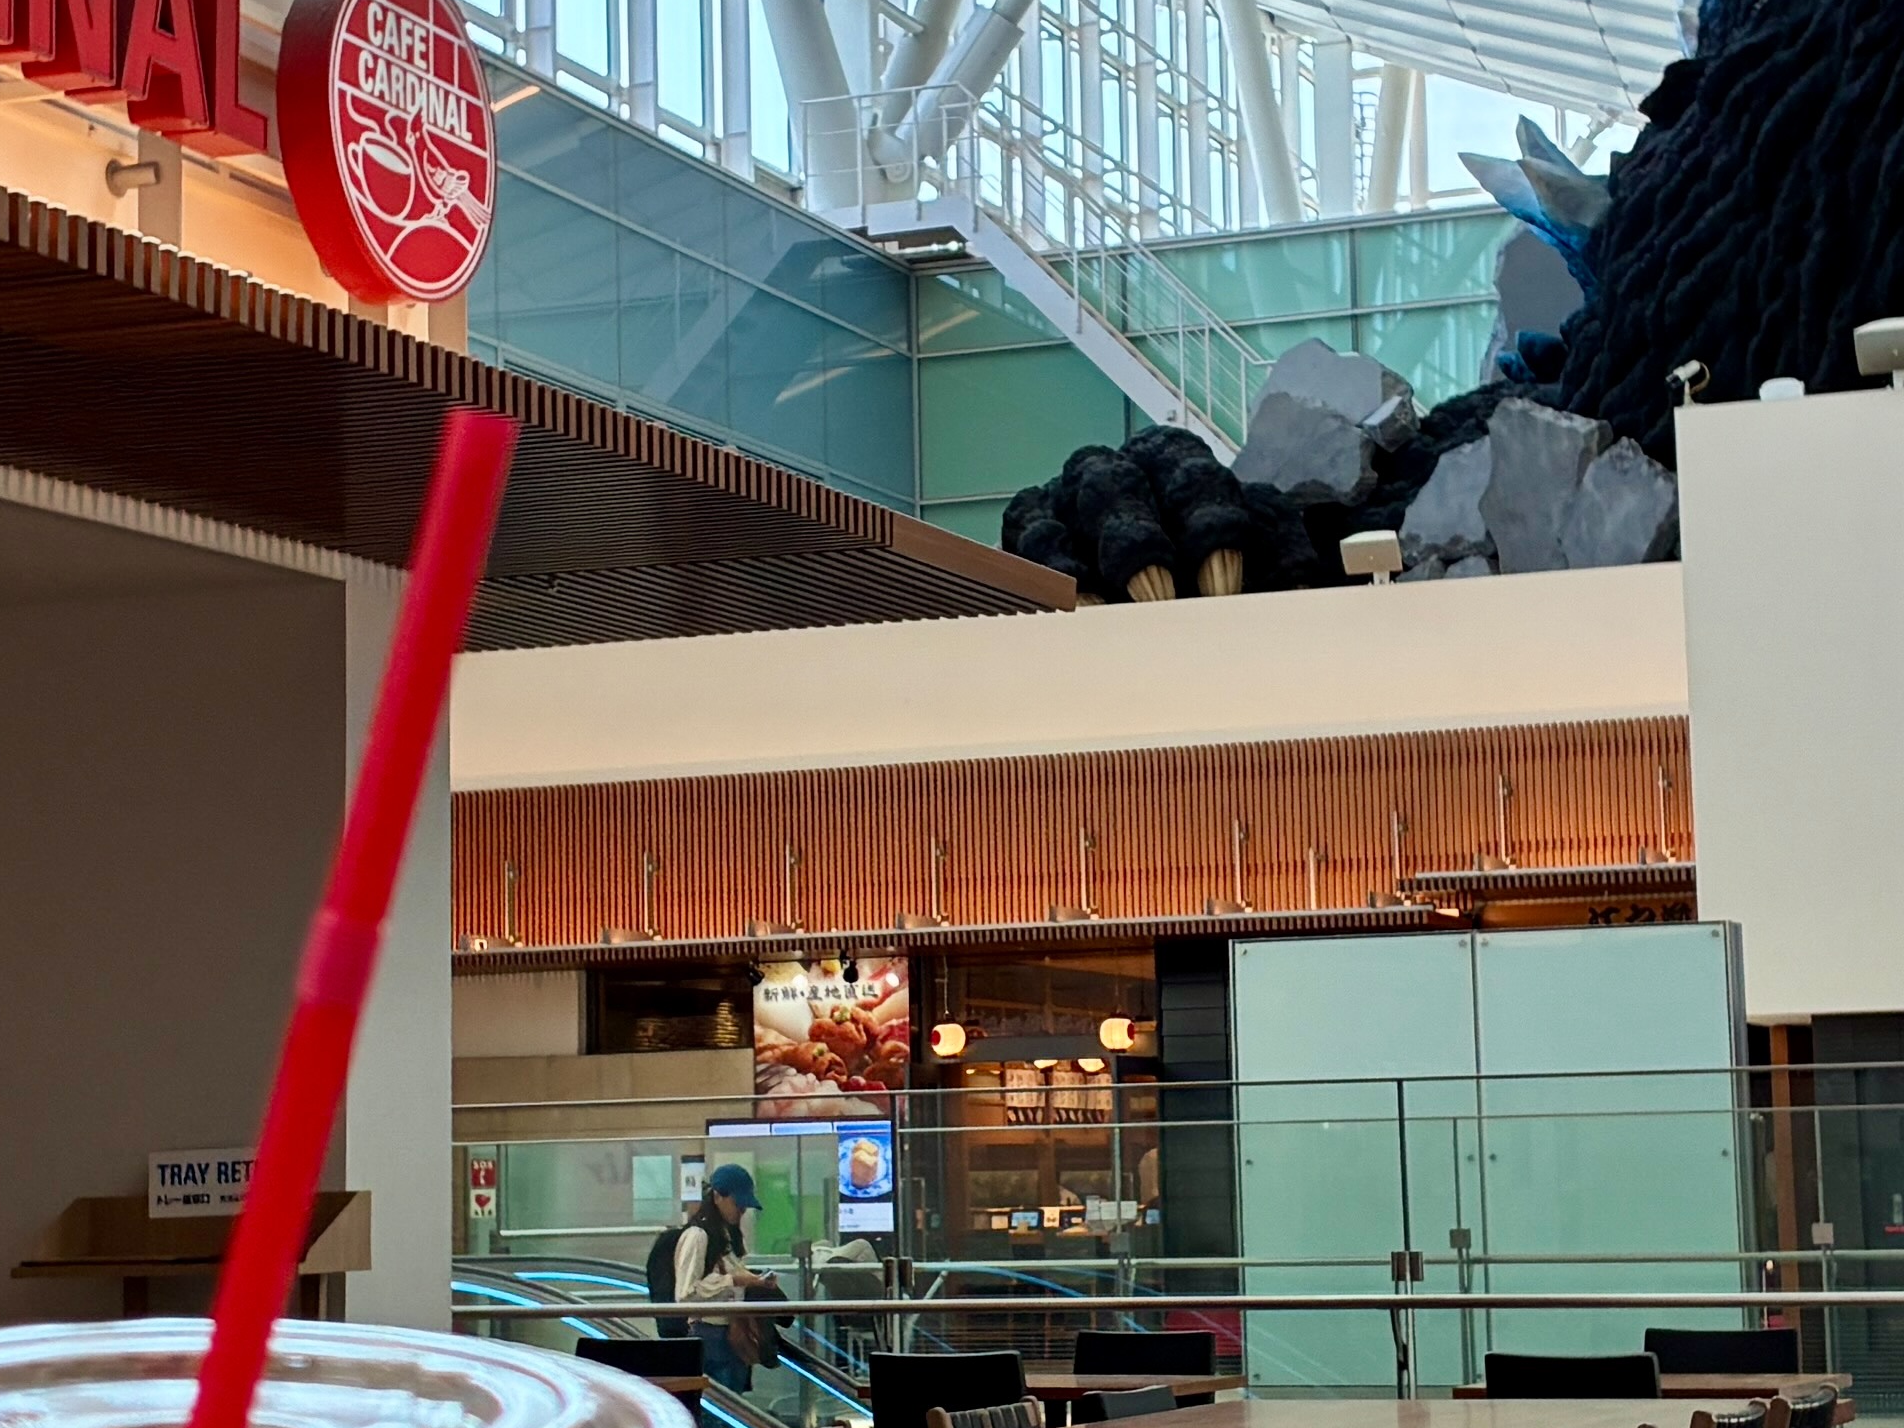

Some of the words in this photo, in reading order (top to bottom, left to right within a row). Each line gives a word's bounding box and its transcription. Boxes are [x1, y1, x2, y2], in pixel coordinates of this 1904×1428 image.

[367, 2, 428, 69] CAFE
[358, 48, 473, 142] CARDINAL
[157, 1162, 209, 1187] TRAY
[217, 1160, 258, 1184] RET
